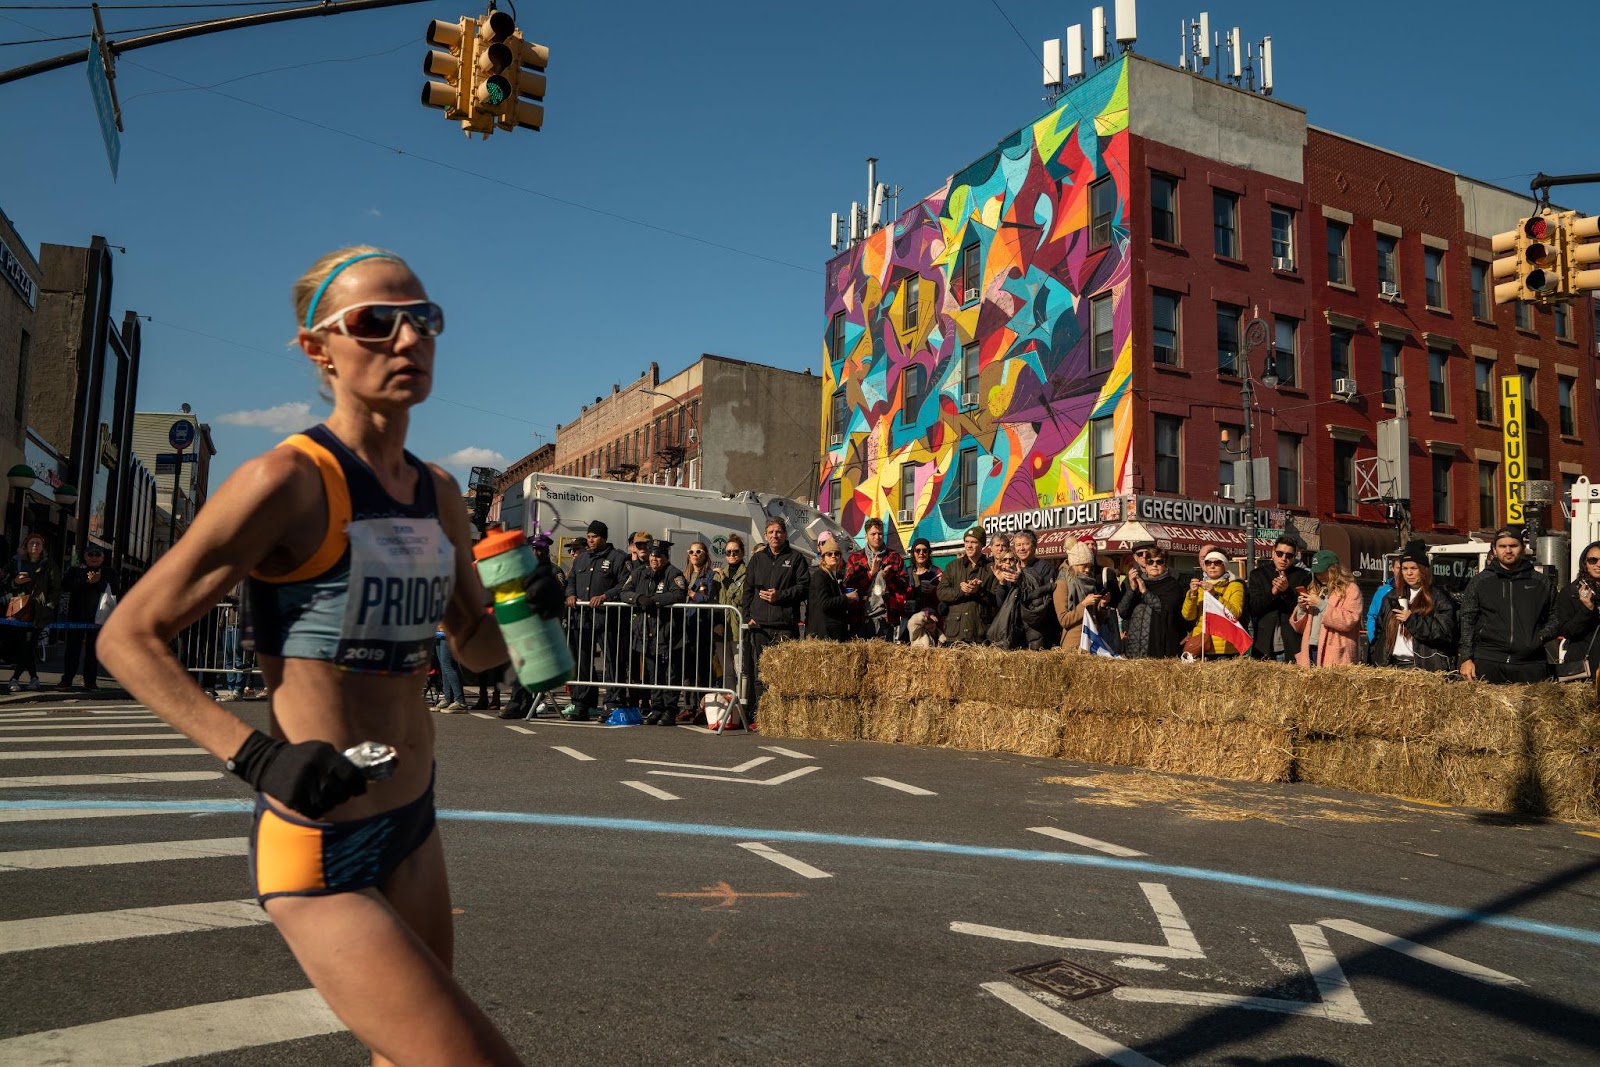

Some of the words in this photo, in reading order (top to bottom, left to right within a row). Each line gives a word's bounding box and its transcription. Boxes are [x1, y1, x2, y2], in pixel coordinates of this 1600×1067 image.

[7, 252, 30, 297] PLAZA
[546, 490, 594, 503] sanitation
[982, 507, 1064, 534] GREENPOINT
[1066, 502, 1097, 525] DELI
[1142, 499, 1236, 526] GREENPOINT
[1163, 525, 1196, 540] DELI
[1194, 528, 1232, 543] GRILL
[1118, 540, 1140, 550] AT
[1433, 563, 1451, 577] nue
[344, 648, 385, 662] 2019
